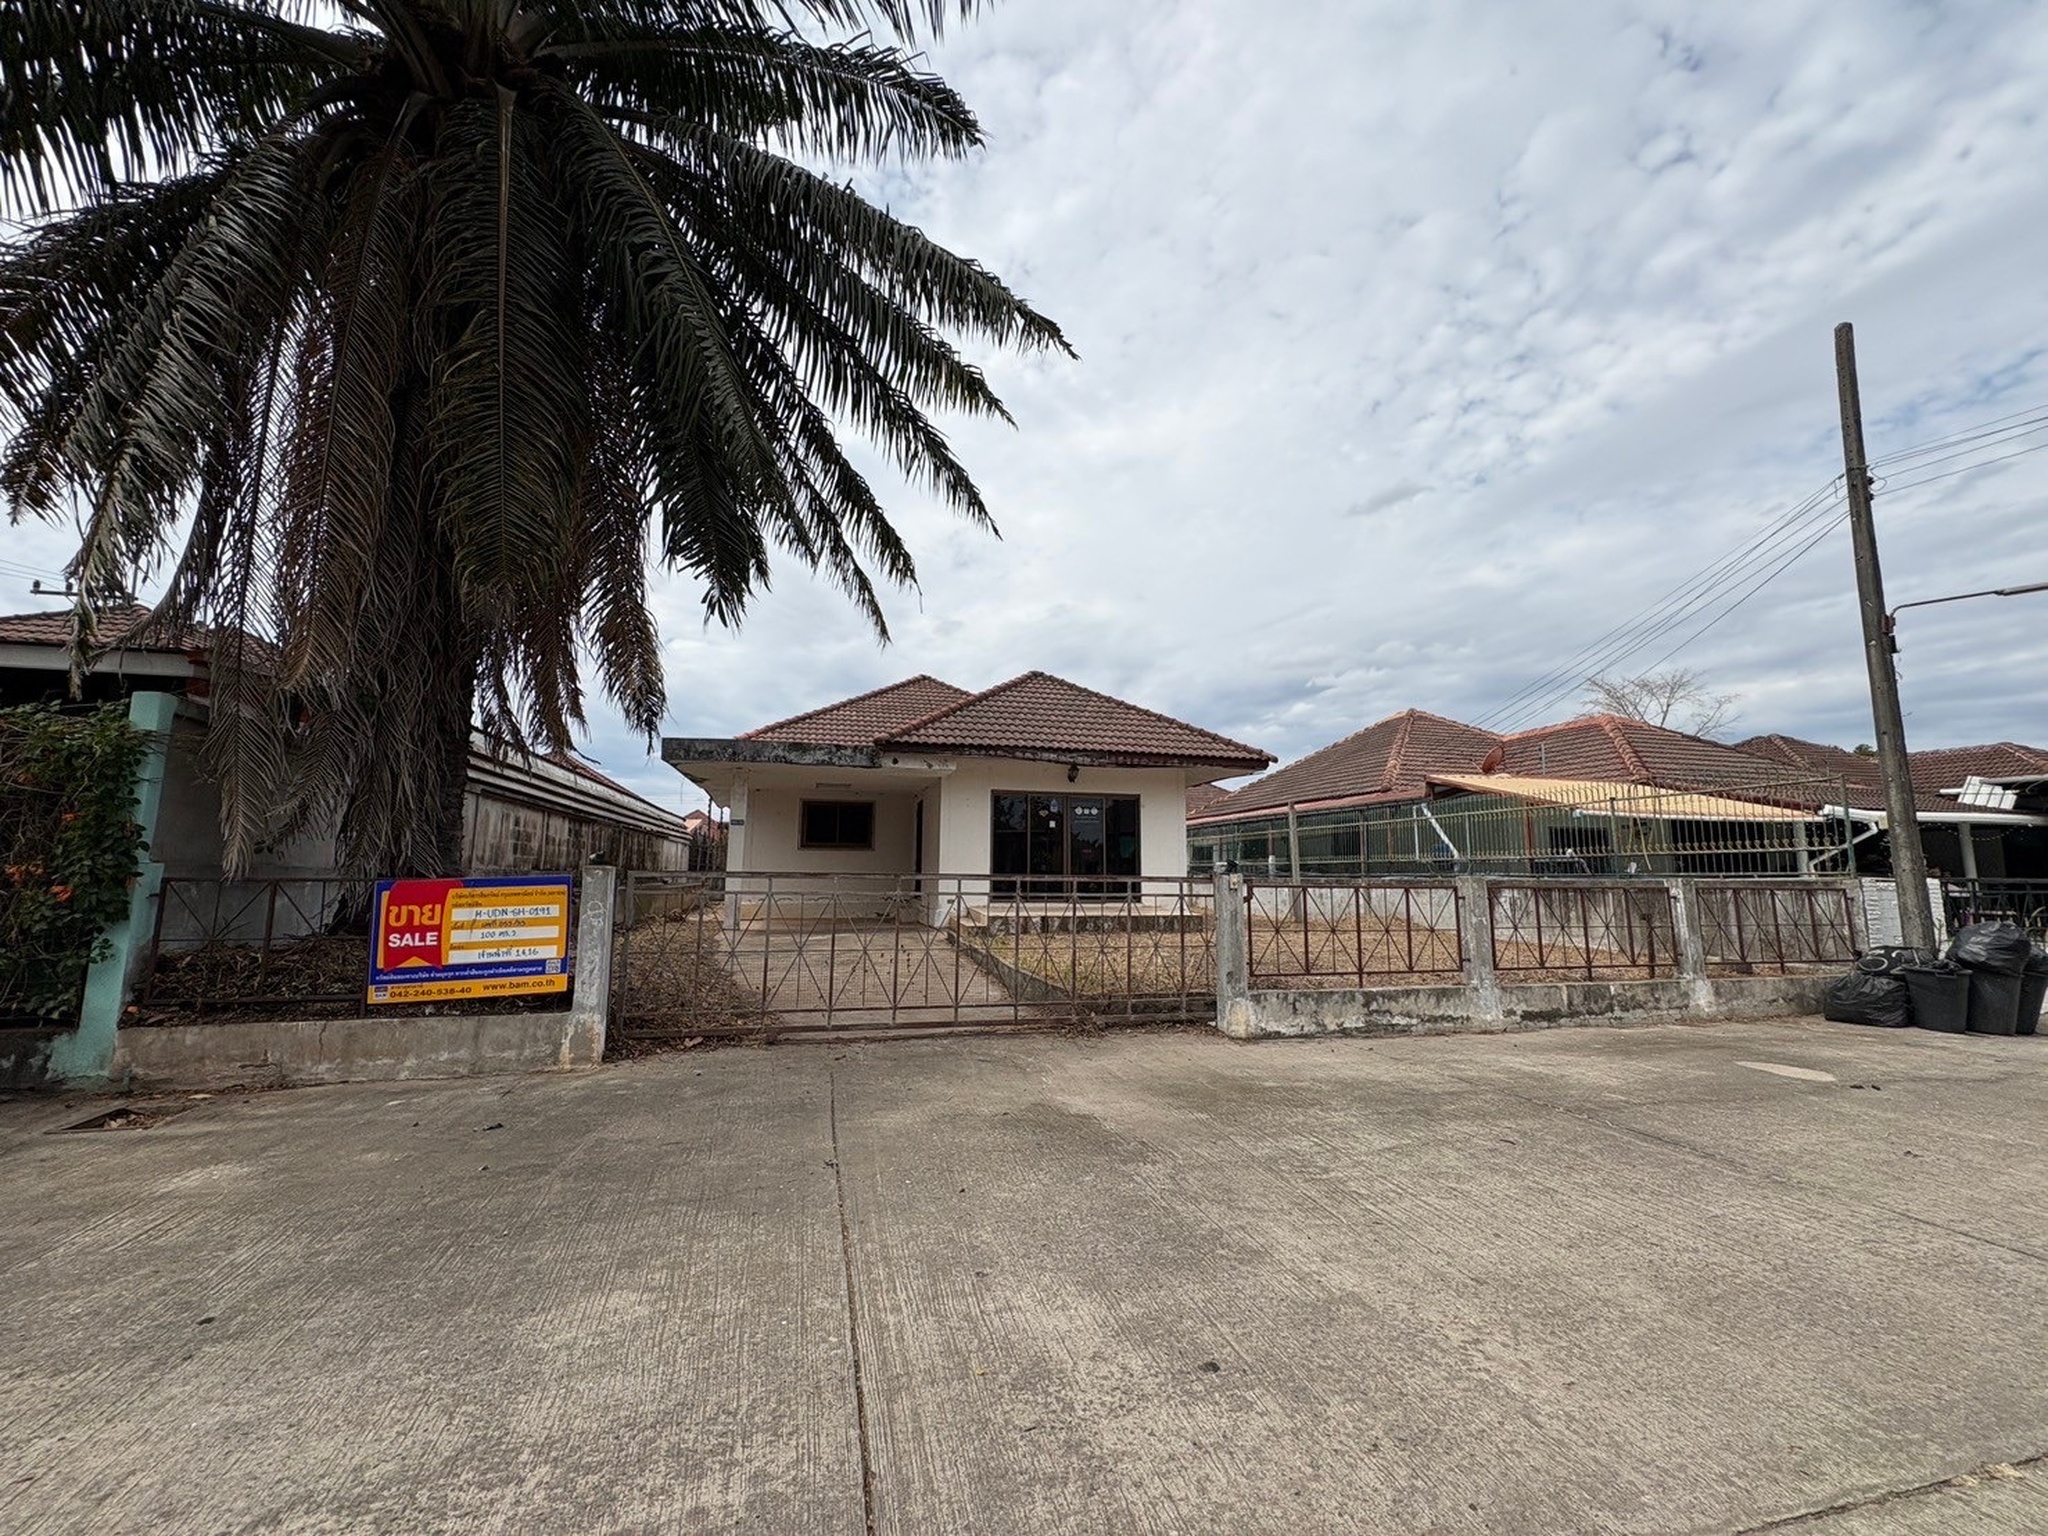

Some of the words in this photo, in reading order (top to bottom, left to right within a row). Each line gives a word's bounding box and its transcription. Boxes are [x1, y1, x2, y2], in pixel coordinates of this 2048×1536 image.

[388, 904, 441, 927] ขาย
[388, 931, 439, 948] SALE
[482, 979, 555, 991] www.bam.co.th
